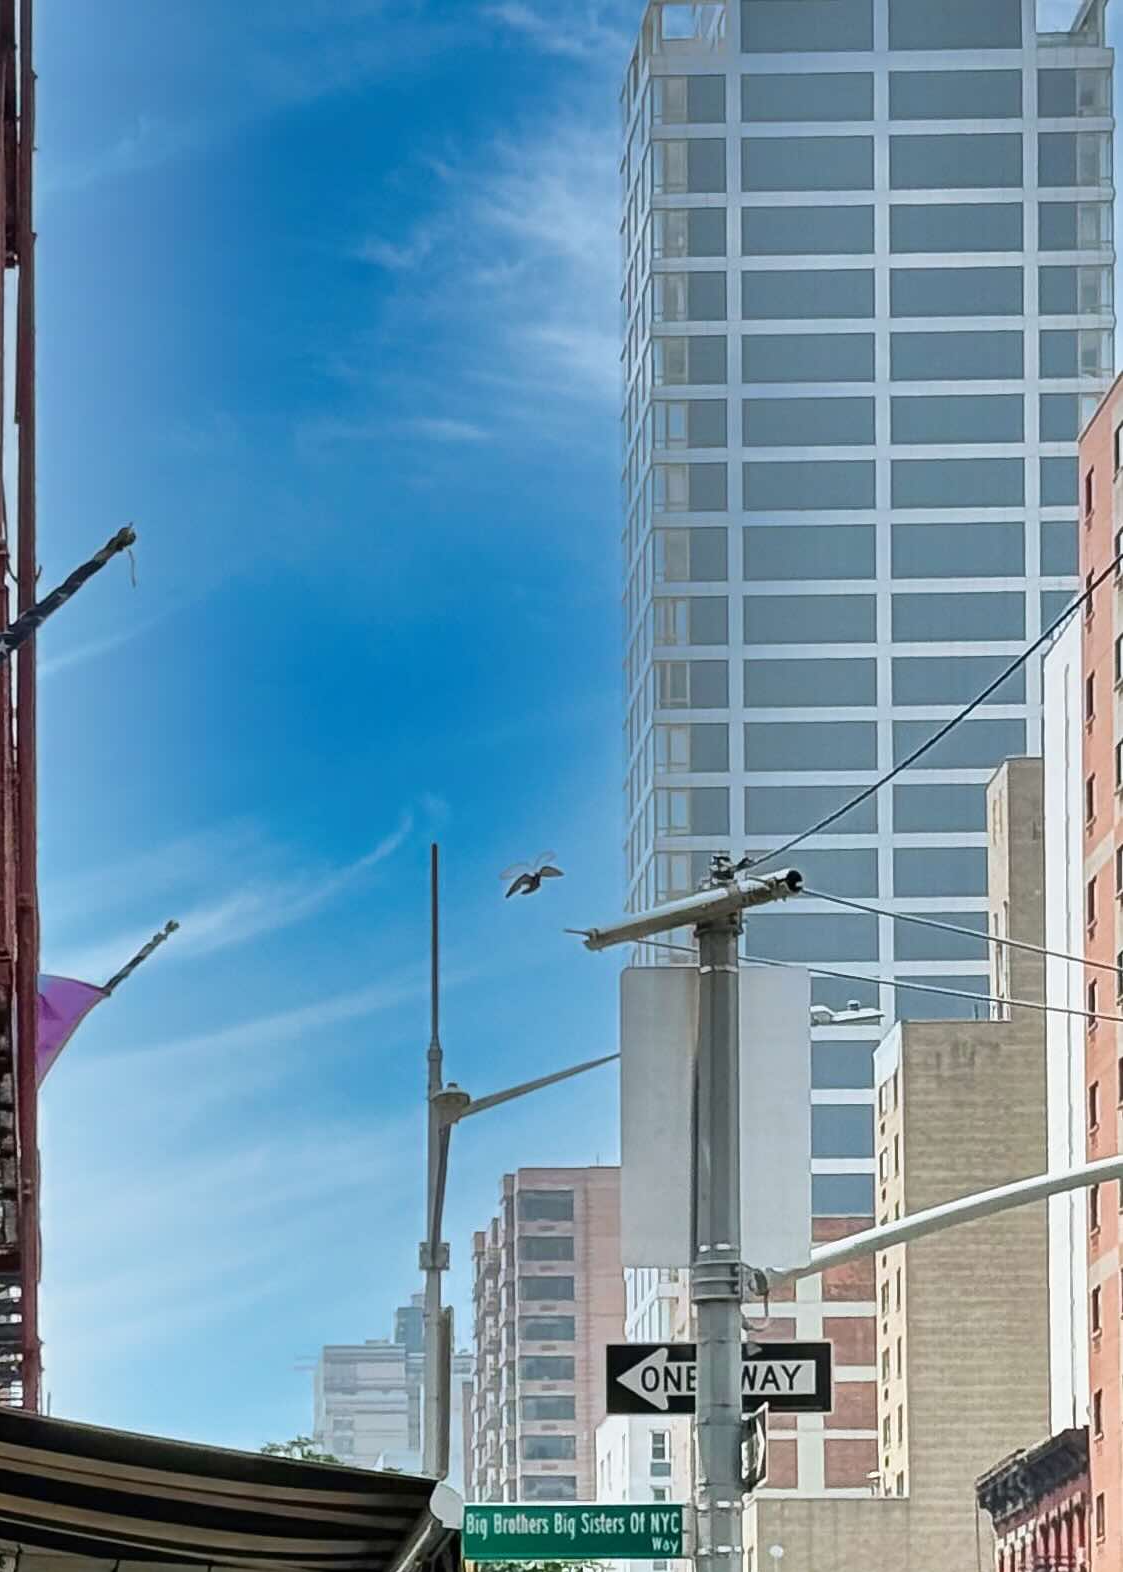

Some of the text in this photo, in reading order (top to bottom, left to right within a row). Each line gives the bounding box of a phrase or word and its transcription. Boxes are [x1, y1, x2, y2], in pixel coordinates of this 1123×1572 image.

[641, 1364, 802, 1392] ONE WAY
[465, 1512, 679, 1540] Big Brothers Big Sisters Of NYC
[651, 1537, 679, 1554] Way
